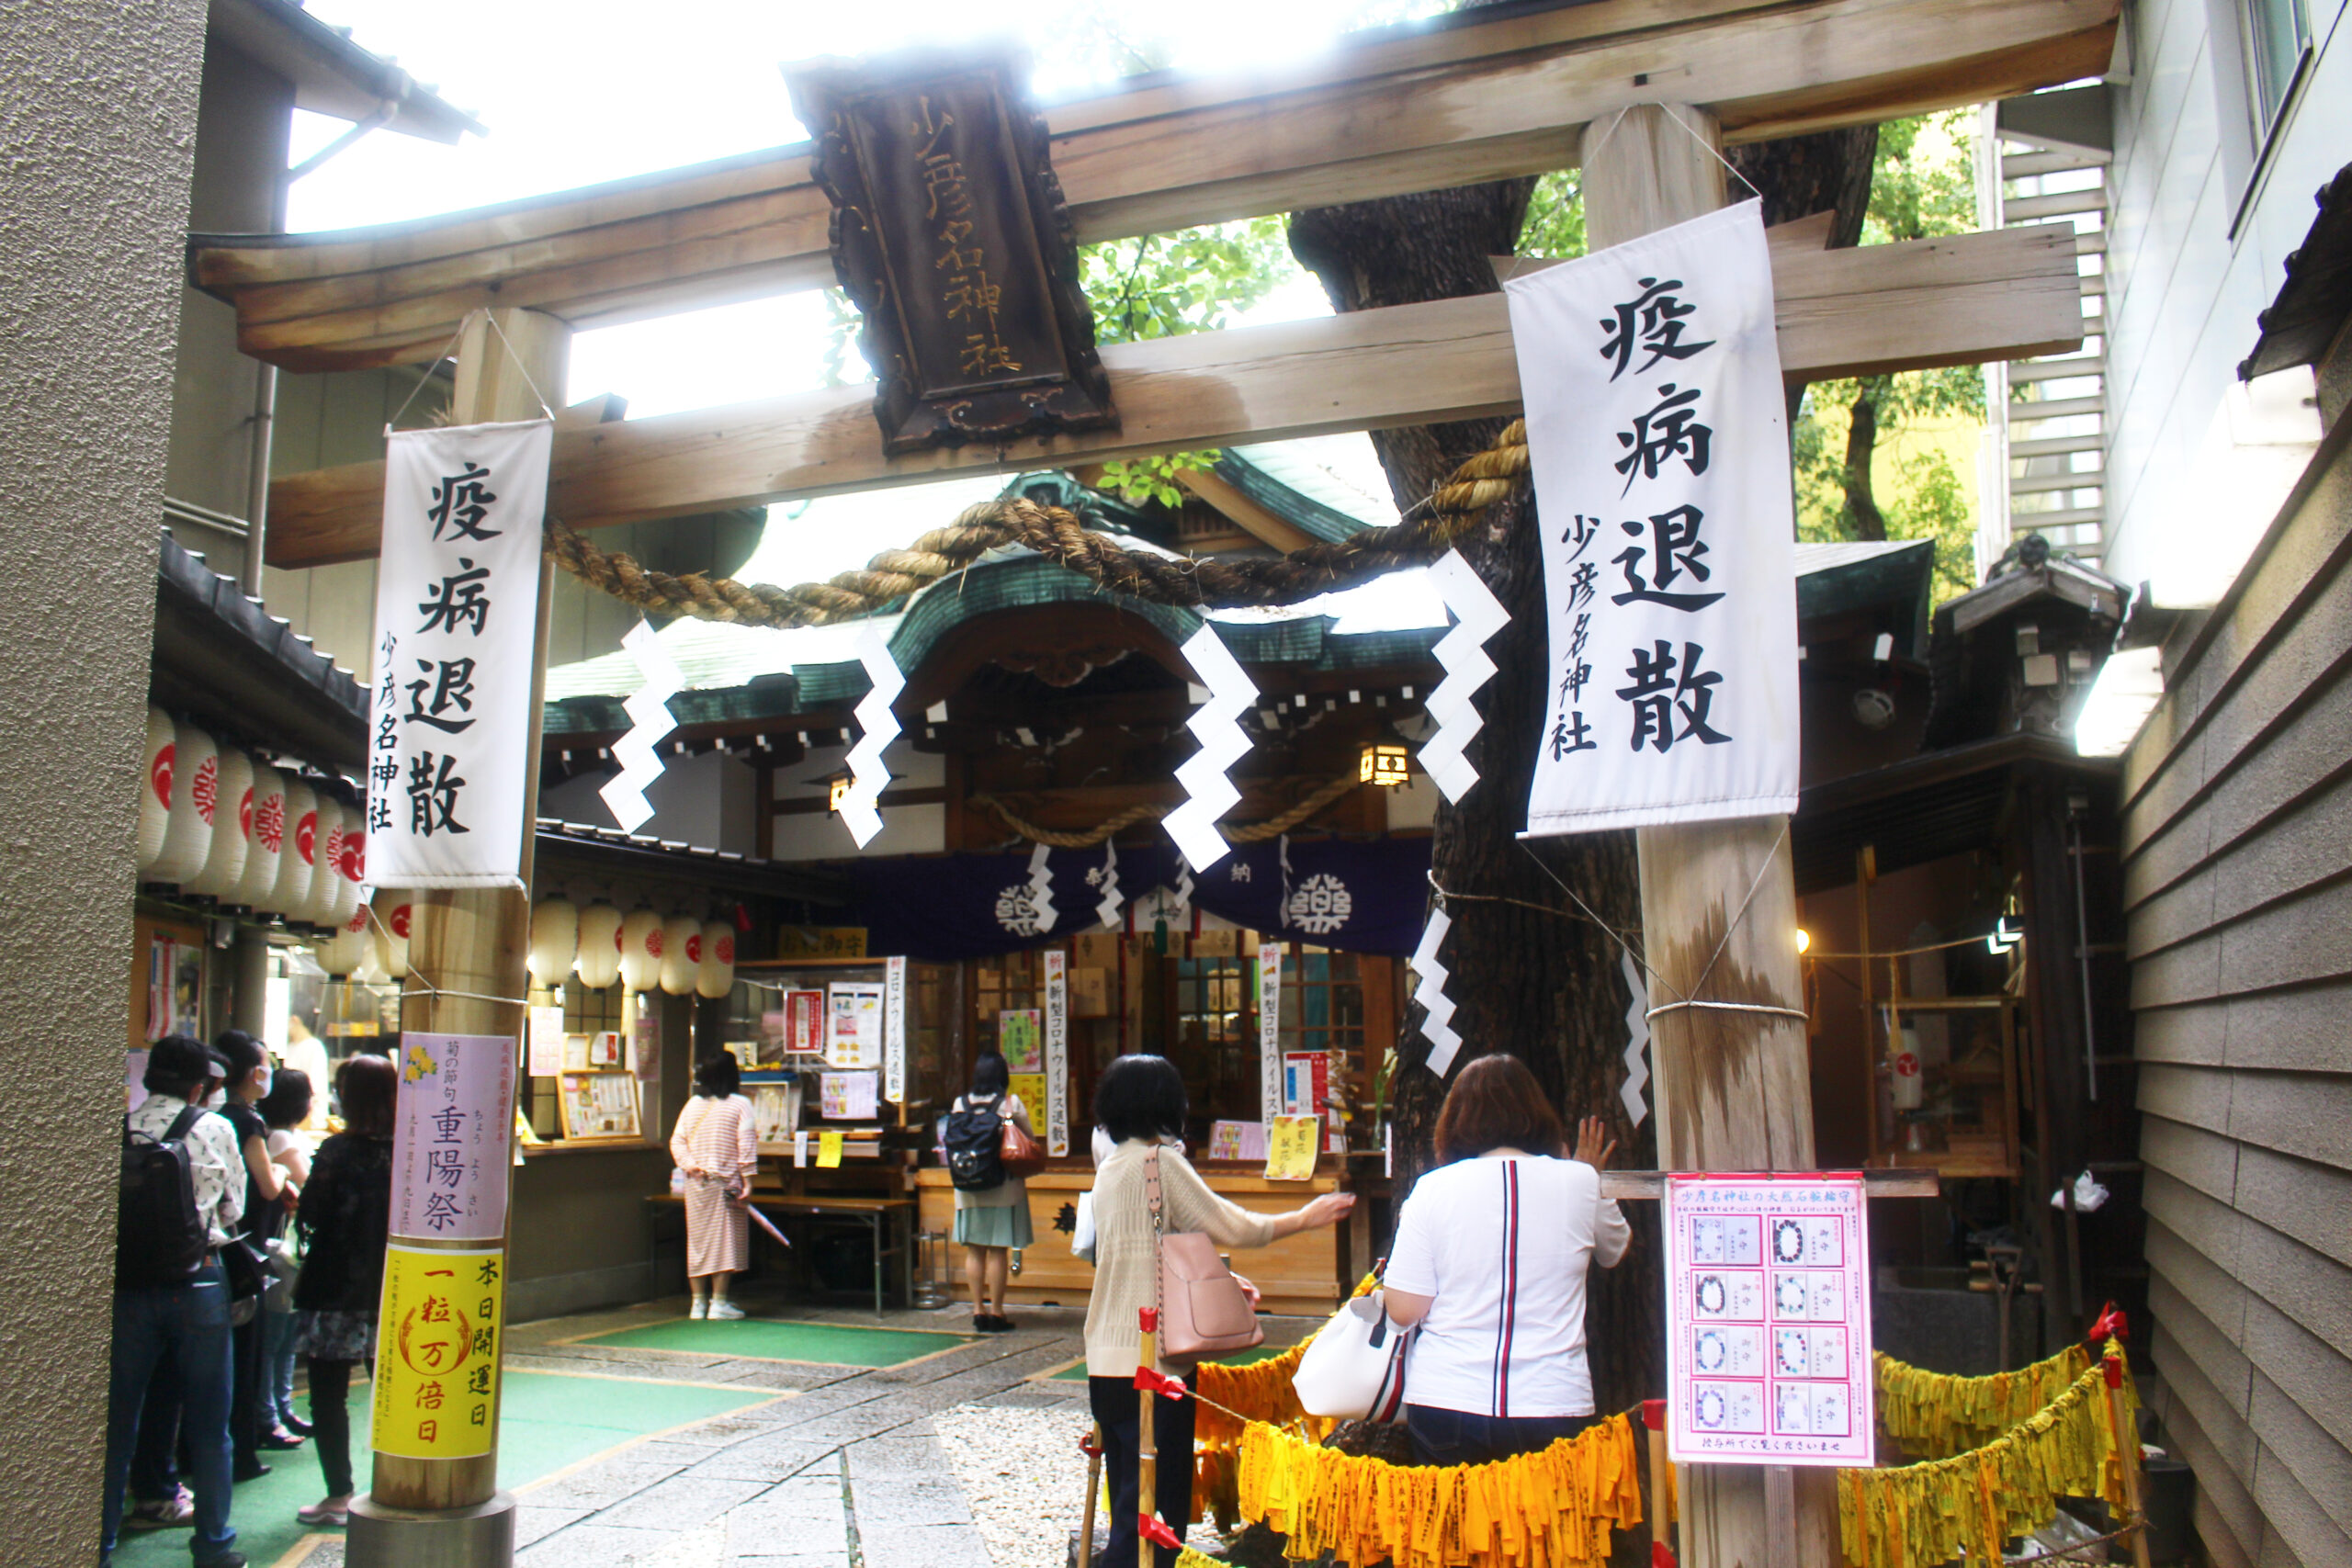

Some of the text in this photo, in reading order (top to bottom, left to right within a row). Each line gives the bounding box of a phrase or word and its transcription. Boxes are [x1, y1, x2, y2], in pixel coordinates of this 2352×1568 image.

[911, 96, 1022, 377] 少彦名神社
[1600, 277, 1733, 754] 疫病退散
[403, 462, 503, 837] 疫病退散
[1548, 514, 1600, 762] 少彦名神社
[368, 631, 399, 835] 少彦名神社
[444, 1041, 459, 1102] 菊の節句
[1048, 986, 1067, 1142] 新型コロナウイルス退散
[423, 1105, 467, 1232] 重陽祭
[415, 1269, 455, 1444] 一粒万倍日
[469, 1259, 499, 1427] 本日開運日
